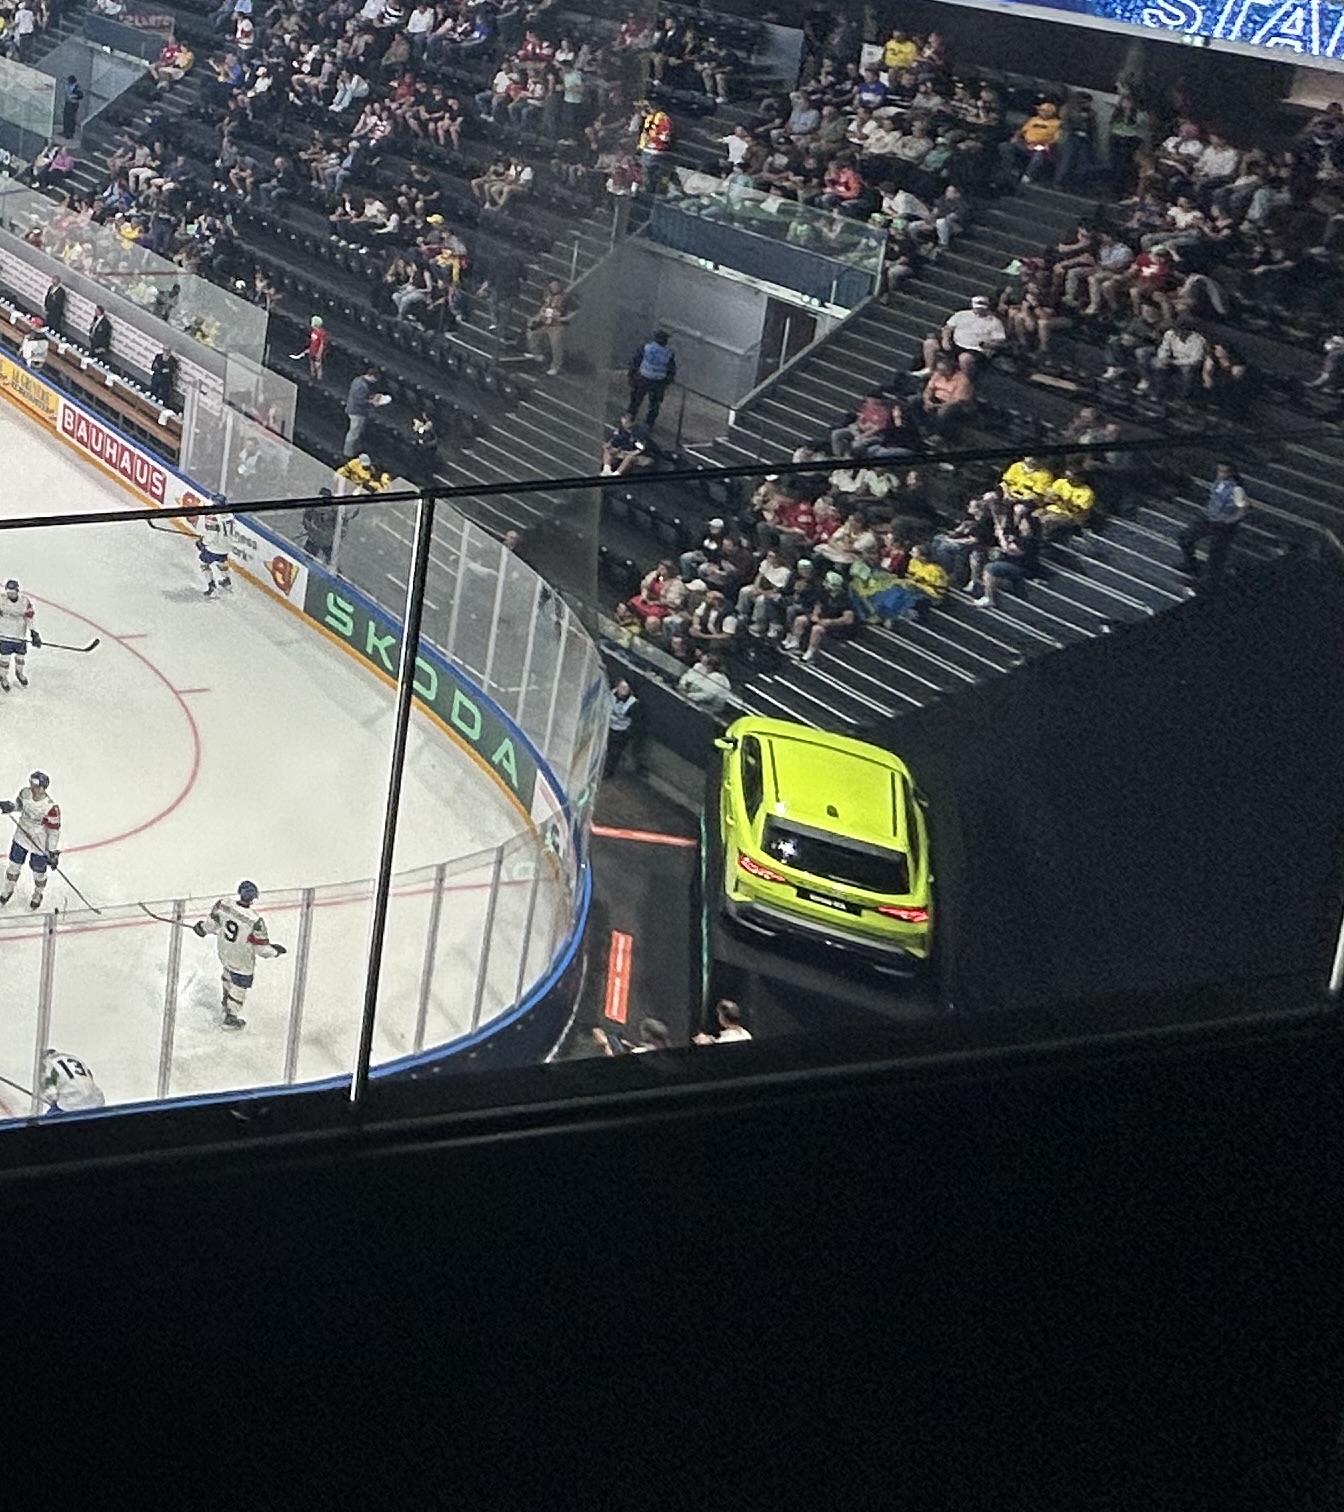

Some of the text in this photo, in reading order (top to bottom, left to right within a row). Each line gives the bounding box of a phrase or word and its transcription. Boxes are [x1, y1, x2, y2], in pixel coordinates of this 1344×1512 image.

[64, 408, 165, 498] BAUHAUS
[324, 592, 520, 788] SKODA
[224, 919, 239, 943] 9
[57, 1057, 89, 1081] 13
